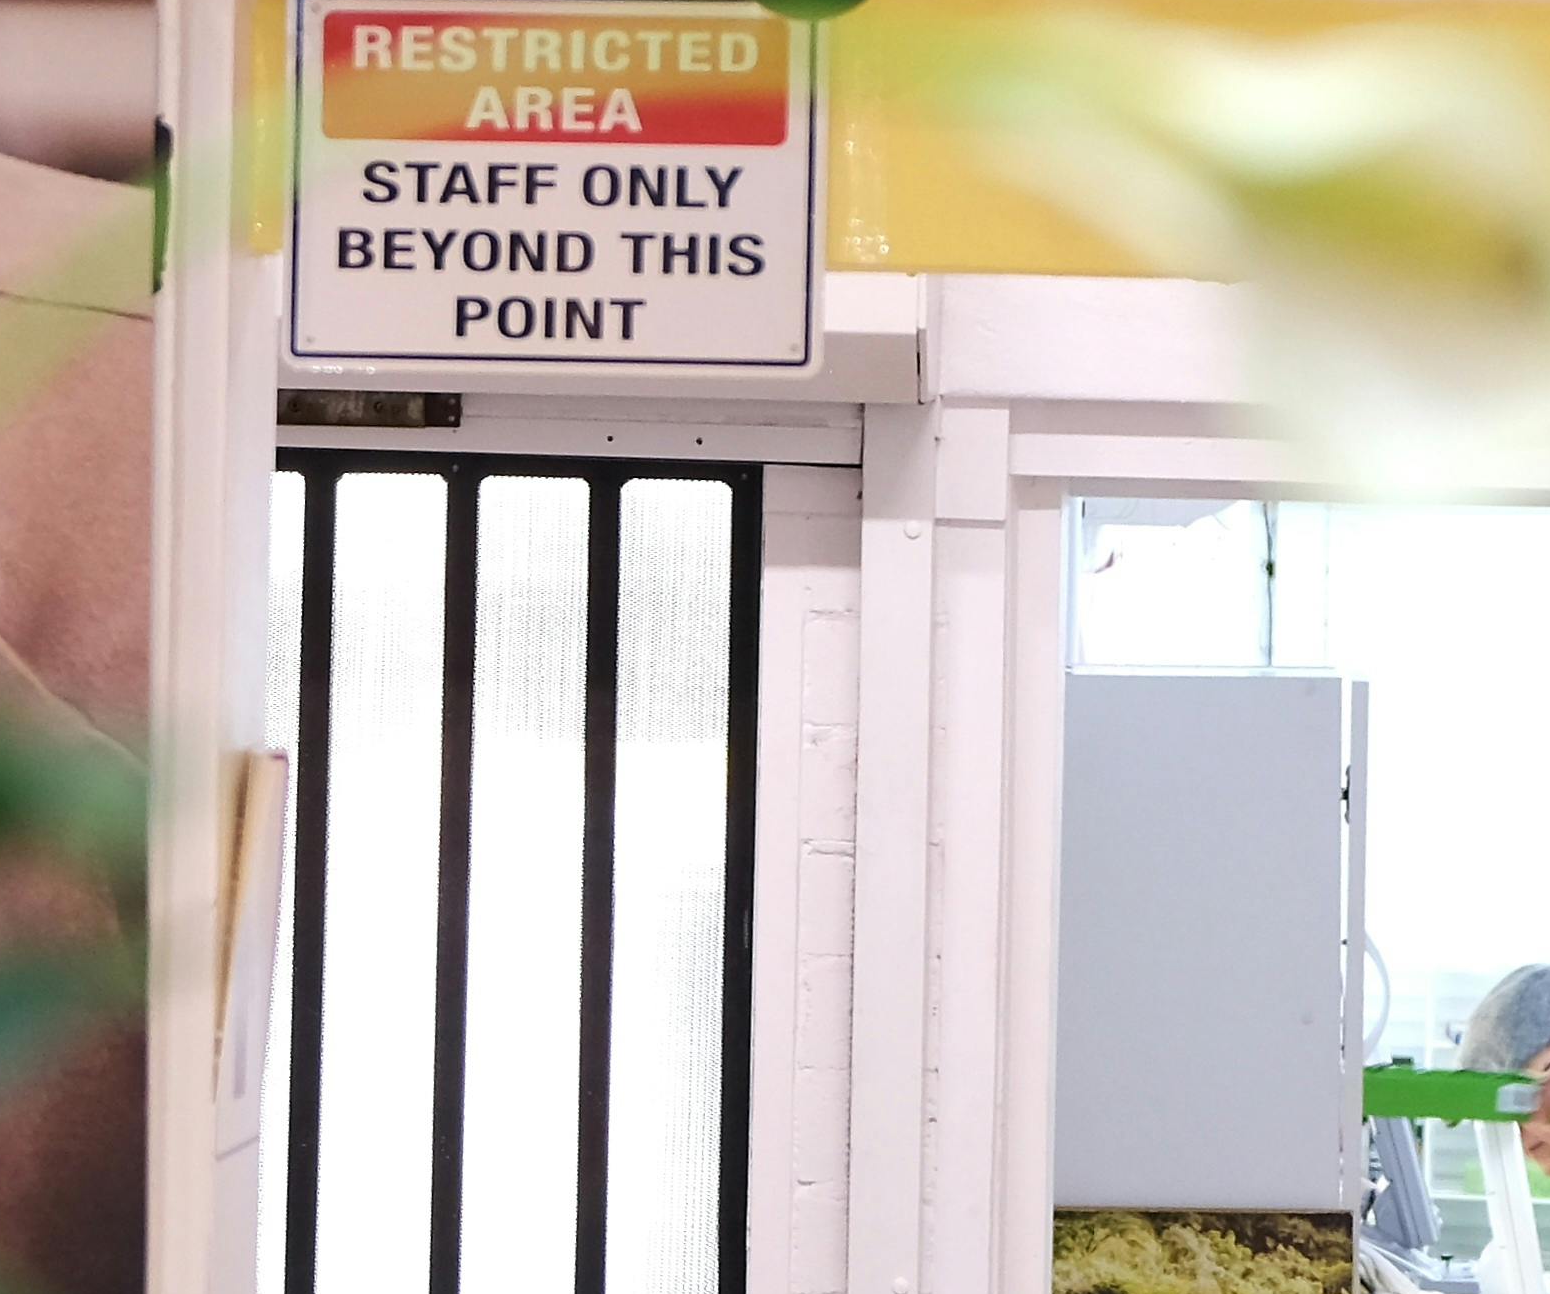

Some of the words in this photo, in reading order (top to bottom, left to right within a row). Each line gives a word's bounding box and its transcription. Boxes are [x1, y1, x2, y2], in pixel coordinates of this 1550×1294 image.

[353, 24, 760, 73] RESTRICTED
[465, 86, 643, 133] AREA
[361, 160, 559, 206] STAFF
[581, 165, 744, 208] ONLY
[337, 228, 595, 274] BEYOND
[619, 232, 766, 276] THIS
[454, 296, 647, 341] POINT
